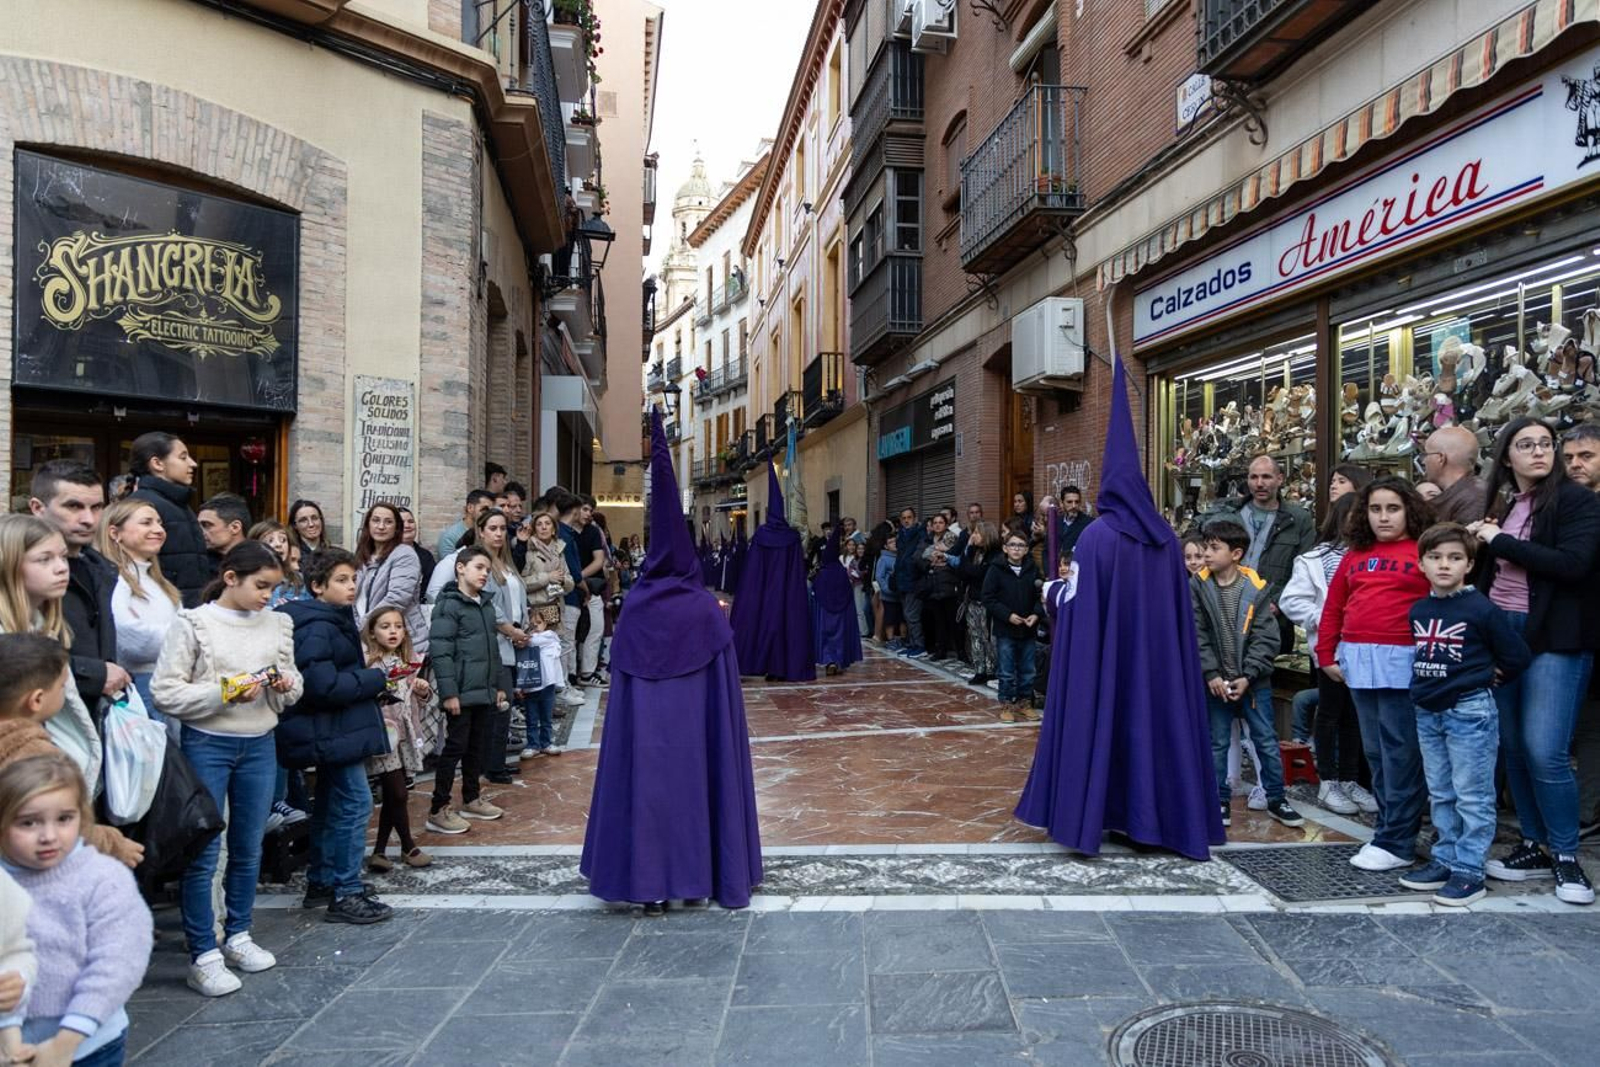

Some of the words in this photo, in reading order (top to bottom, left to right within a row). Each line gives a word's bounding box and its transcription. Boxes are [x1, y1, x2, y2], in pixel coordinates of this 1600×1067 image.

[1150, 261, 1252, 321] Calzados
[1278, 157, 1490, 278] América
[150, 319, 199, 340] ELECTRIC
[202, 326, 253, 347] TATTOOING
[361, 391, 408, 408] COLORES
[367, 406, 408, 421] SOLIDOS
[597, 494, 641, 503] ONATO
[1350, 559, 1415, 575] LOVELY
